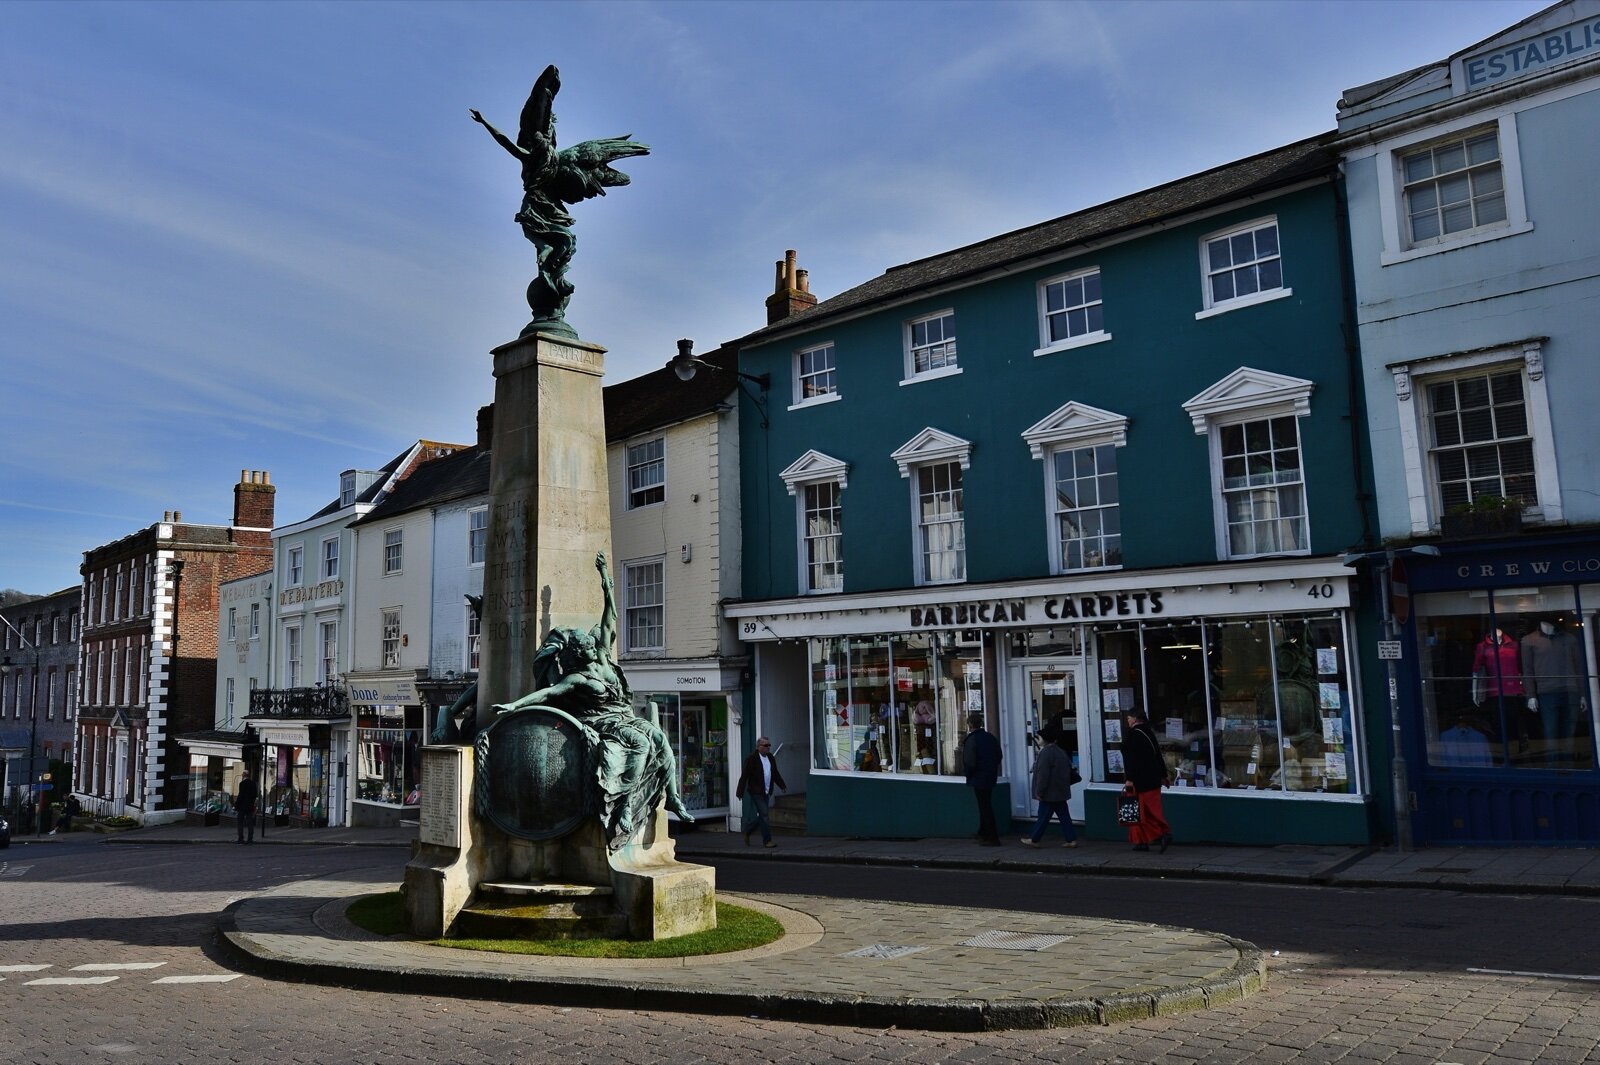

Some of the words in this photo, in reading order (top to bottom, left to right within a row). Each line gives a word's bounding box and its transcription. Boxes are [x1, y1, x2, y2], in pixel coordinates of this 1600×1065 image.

[1457, 561, 1552, 578] CREW
[1307, 583, 1335, 599] 40
[910, 602, 1027, 627] BARBICAN
[1044, 592, 1164, 620] CARPETS
[743, 621, 757, 634] 39
[350, 685, 379, 701] bone
